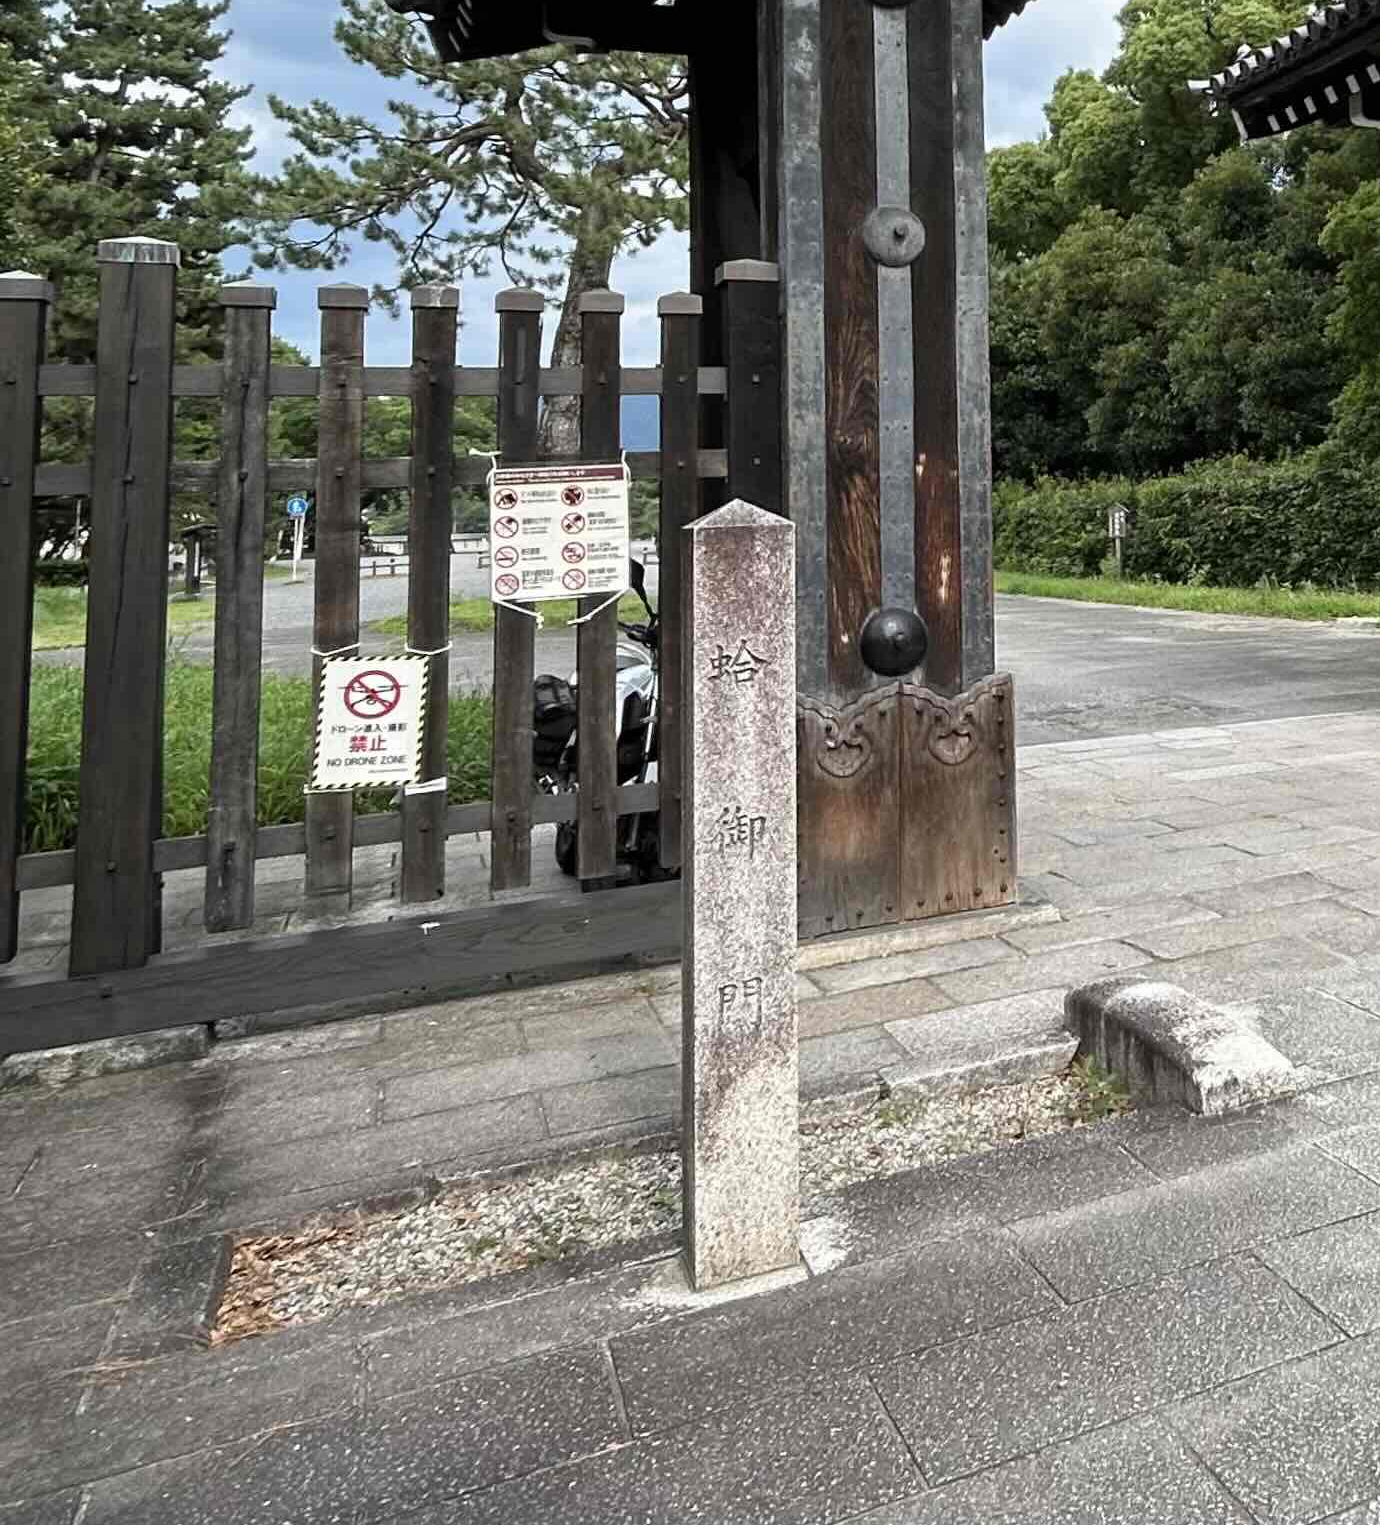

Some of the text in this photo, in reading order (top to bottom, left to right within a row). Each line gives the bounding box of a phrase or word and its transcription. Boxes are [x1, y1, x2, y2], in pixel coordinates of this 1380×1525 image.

[349, 735, 387, 753] 禁止
[327, 755, 408, 767] NO DRONE ZONE
[707, 638, 769, 1032] 蛤御門
